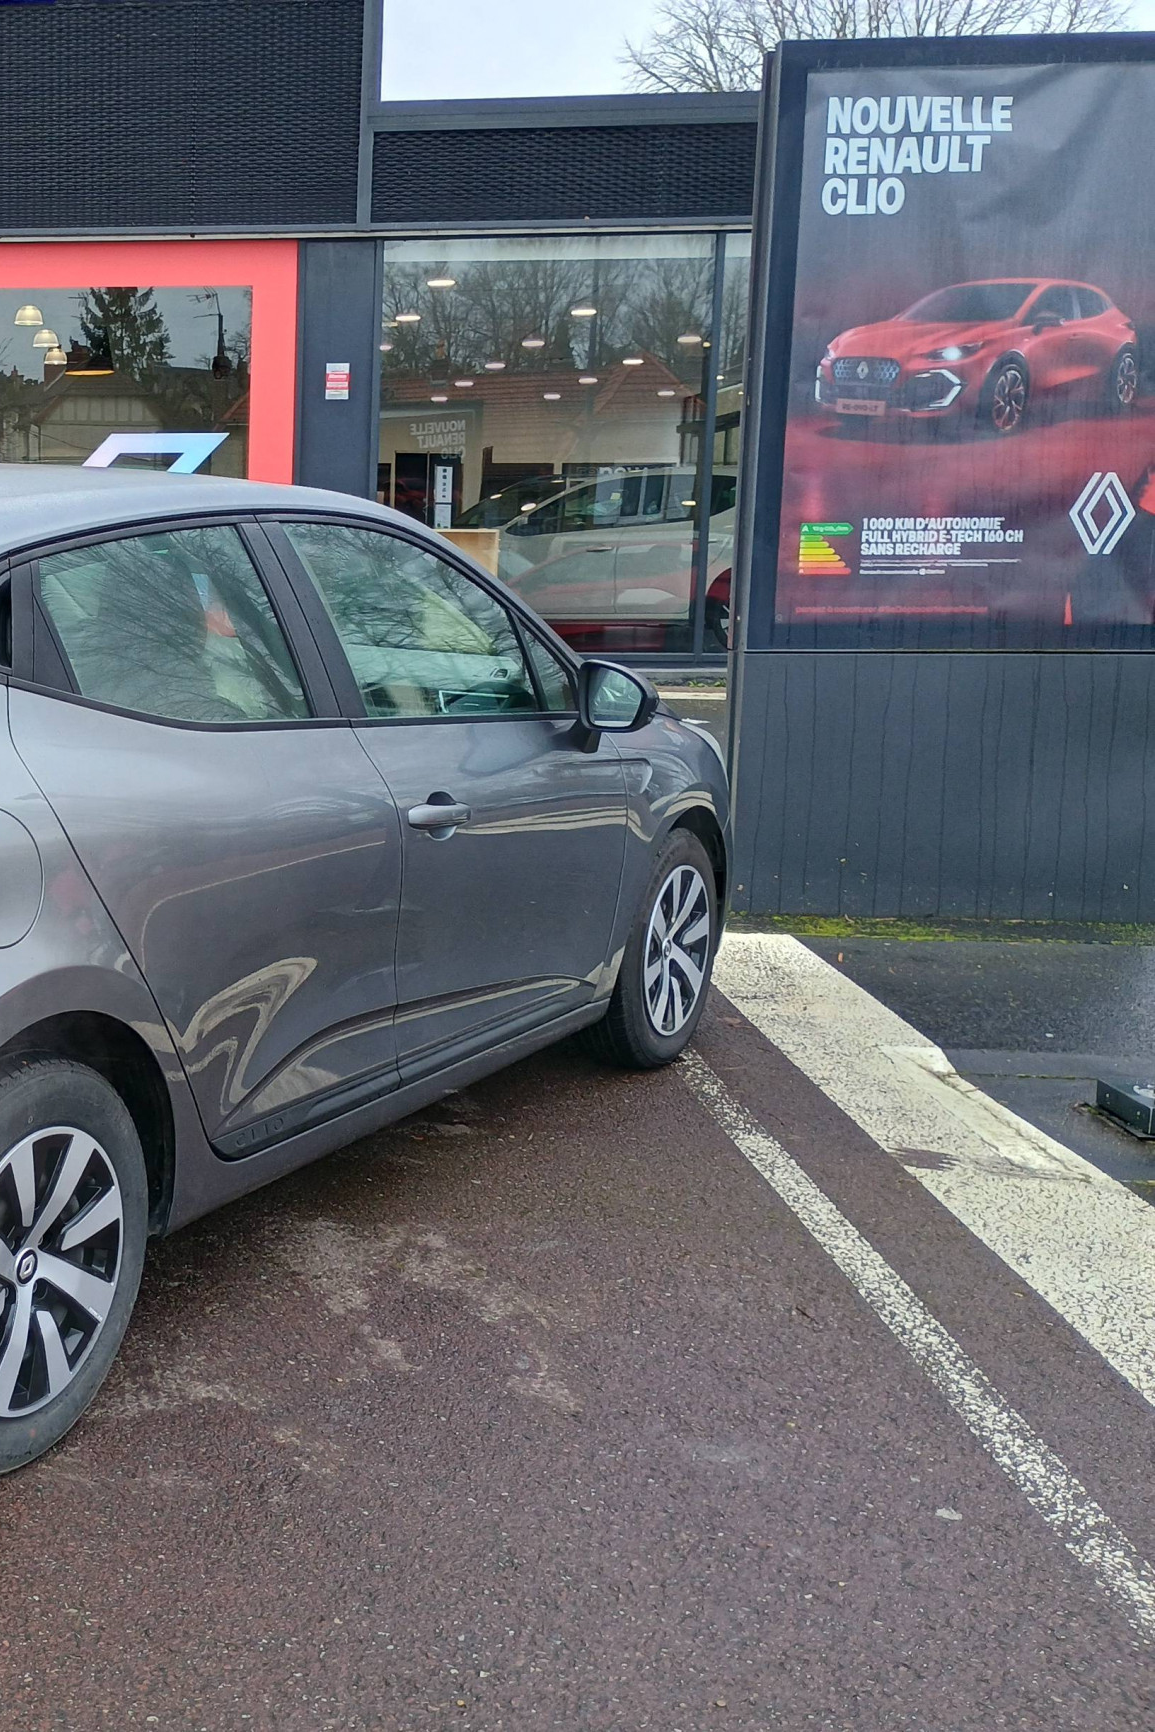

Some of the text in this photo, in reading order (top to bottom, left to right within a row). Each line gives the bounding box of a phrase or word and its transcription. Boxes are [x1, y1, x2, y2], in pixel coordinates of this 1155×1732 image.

[827, 96, 1014, 134] NOUVELLE
[824, 135, 991, 175] RENAULT
[821, 177, 906, 216] CLIO
[861, 529, 1024, 543] FULL HYBRID E-TECH 160 CH
[894, 518, 915, 530] KM
[860, 542, 962, 556] SANS RECHARGE
